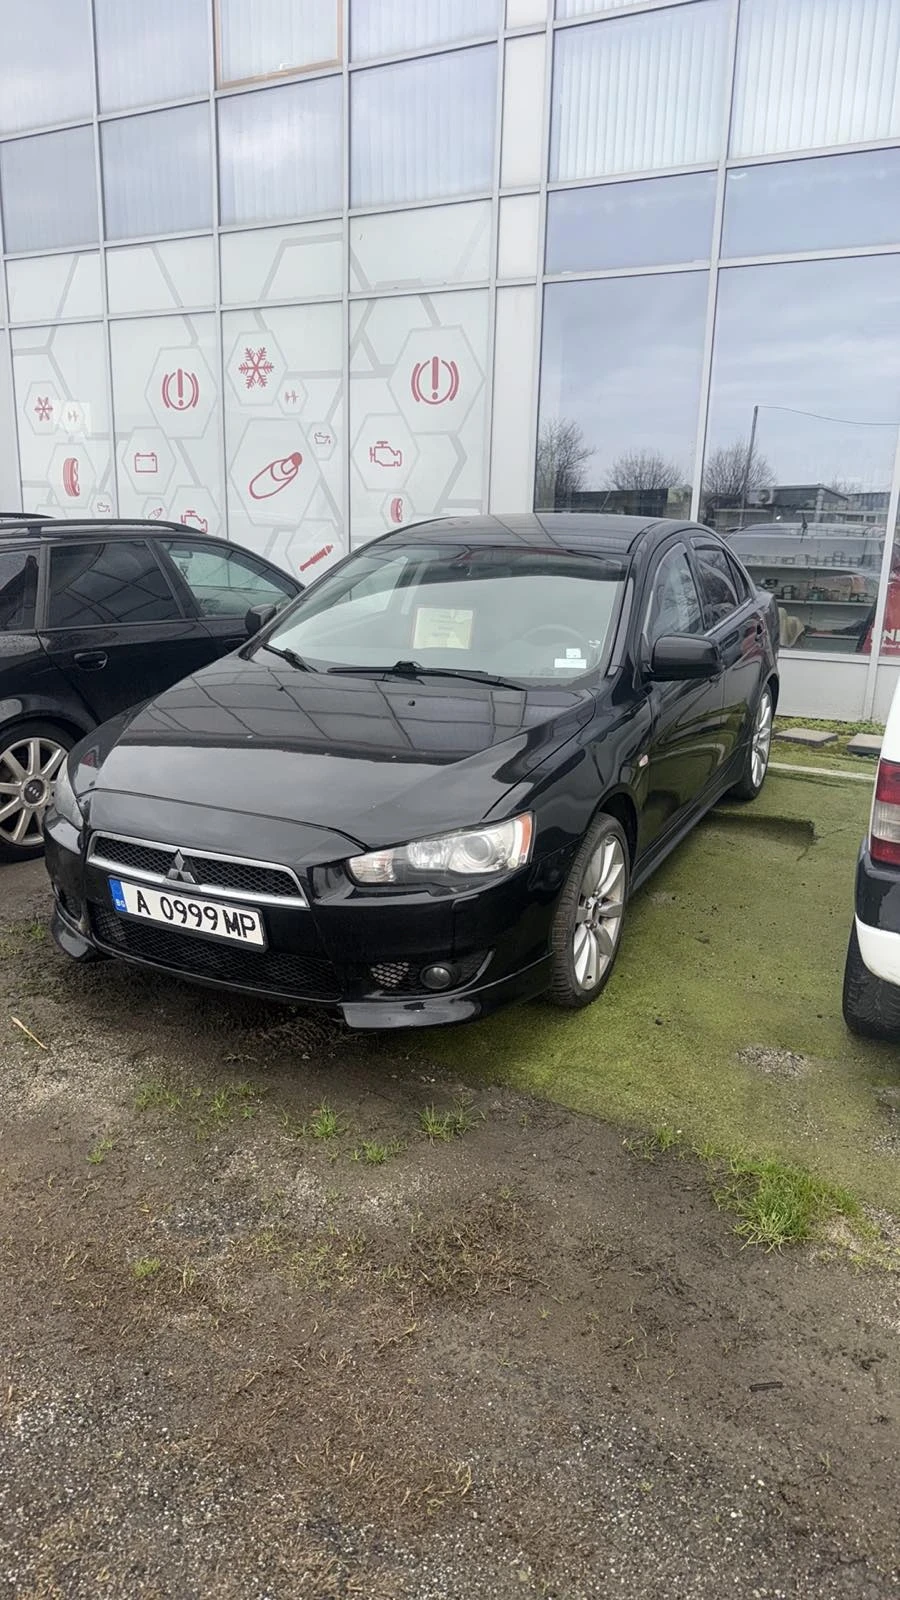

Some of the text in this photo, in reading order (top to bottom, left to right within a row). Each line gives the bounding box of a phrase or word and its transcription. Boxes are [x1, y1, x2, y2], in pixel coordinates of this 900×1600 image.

[137, 890, 256, 938] A 0999 MP
